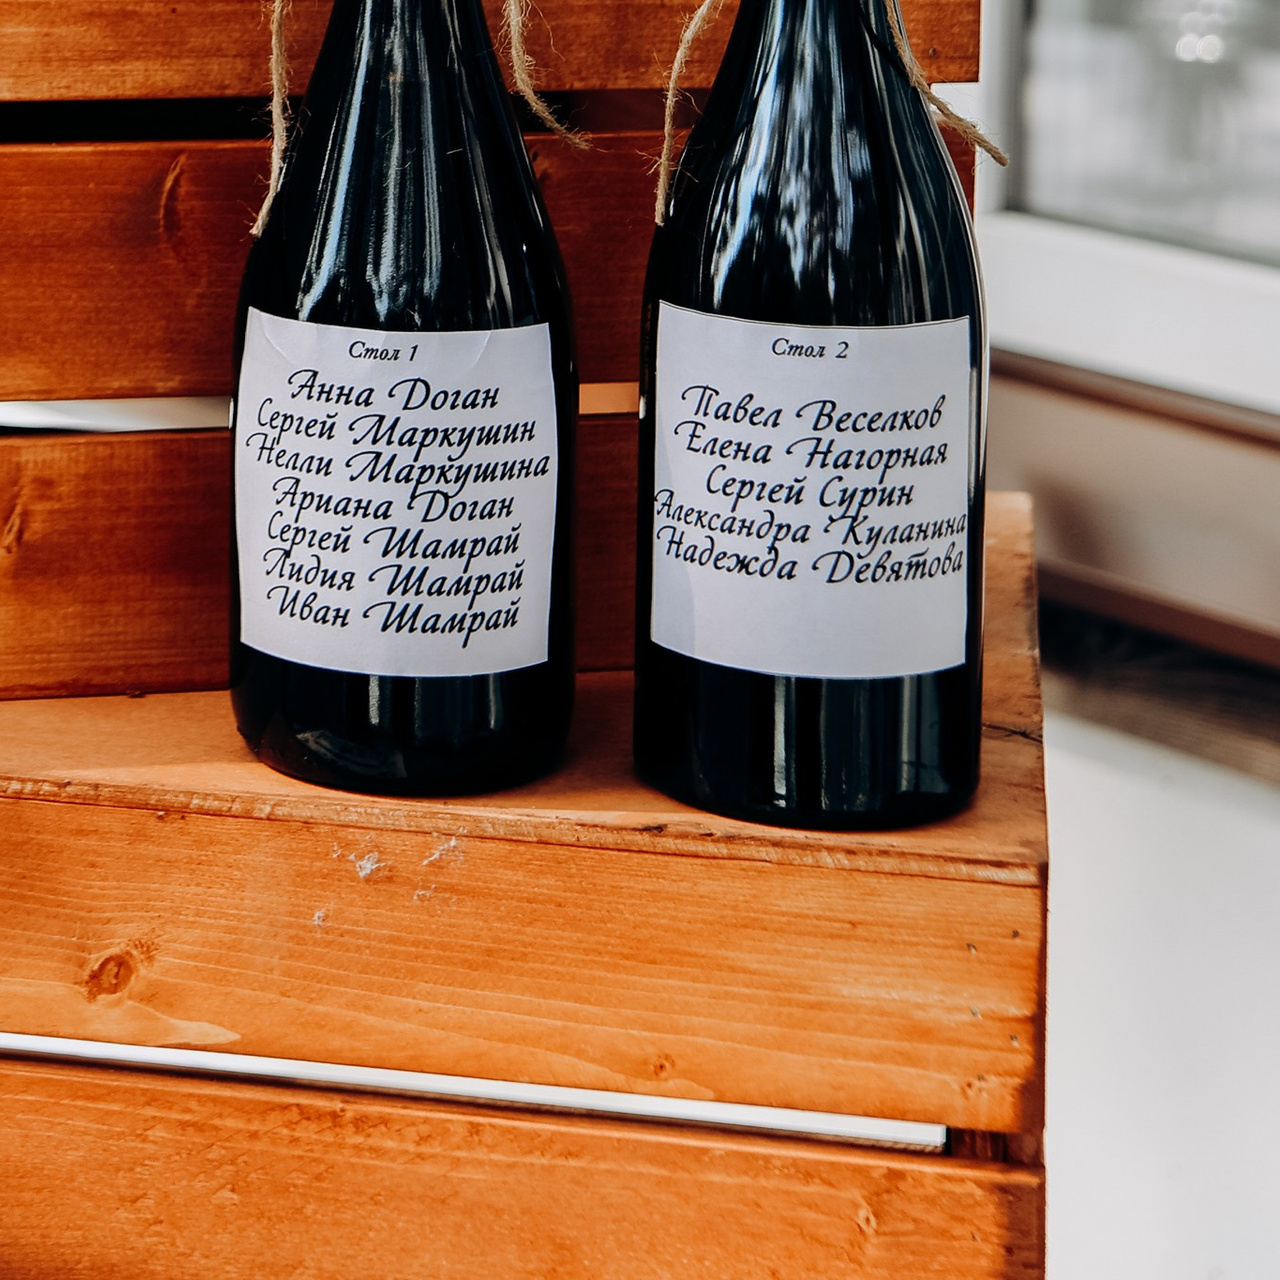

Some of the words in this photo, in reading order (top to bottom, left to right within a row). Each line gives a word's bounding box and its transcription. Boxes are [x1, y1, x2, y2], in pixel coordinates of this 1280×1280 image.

[348, 341, 400, 361] Стол
[409, 345, 418, 361] 1
[772, 338, 825, 358] Стол
[835, 342, 849, 358] 2
[288, 369, 374, 407] Анна
[388, 377, 499, 411] Доган
[681, 385, 782, 428] Павел
[795, 395, 946, 432] Веселков
[257, 398, 338, 449] Сергей
[348, 414, 536, 462] Маркушин
[674, 421, 772, 464] Елена
[785, 437, 948, 484] Нагорная
[246, 432, 333, 476] Нелли
[345, 451, 550, 500] Маркушина
[706, 465, 807, 512] Сергей
[819, 476, 915, 520] Сурин
[272, 477, 393, 523] Ариана
[407, 489, 515, 522] Доган
[654, 489, 811, 555] Александра
[823, 513, 968, 556] Куланина
[268, 511, 353, 556] Сергей
[363, 523, 522, 572] Шамрай
[657, 526, 798, 581] Надежда
[811, 542, 963, 583] Девятова
[263, 548, 356, 591] Лидия
[368, 559, 525, 609] Шамрай
[267, 586, 350, 628] Иван
[362, 598, 521, 648] Шамрай
